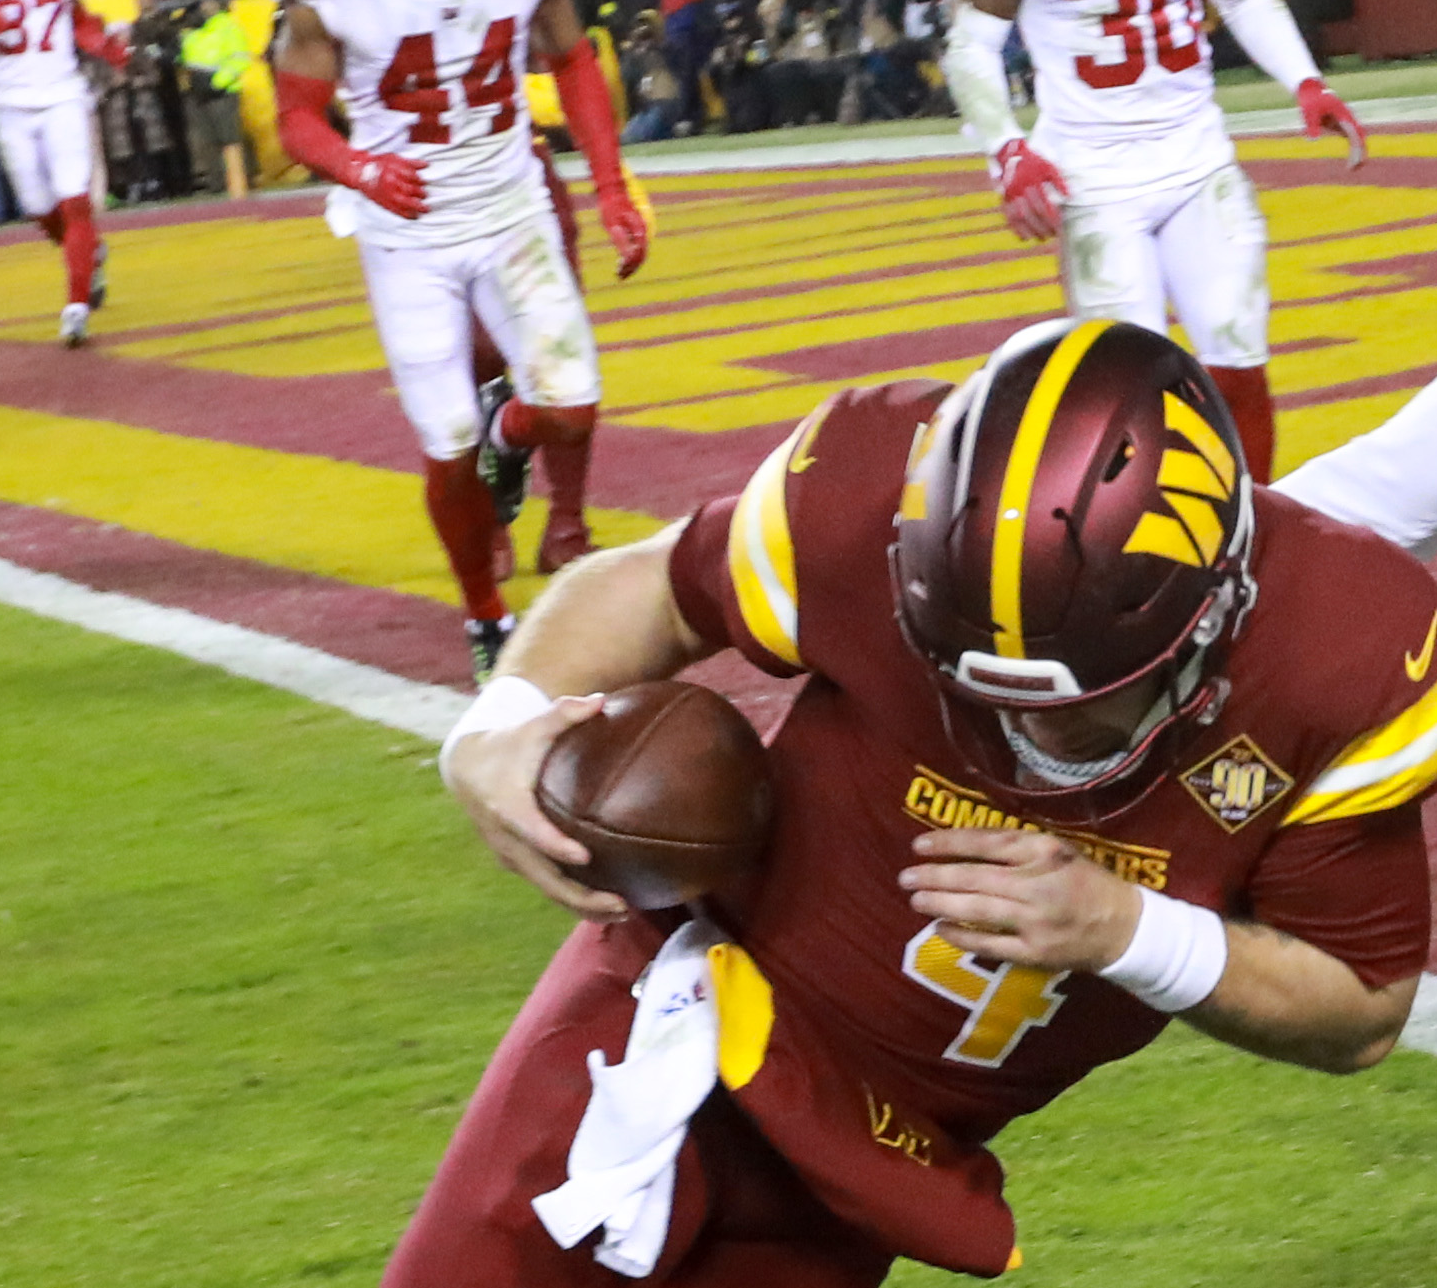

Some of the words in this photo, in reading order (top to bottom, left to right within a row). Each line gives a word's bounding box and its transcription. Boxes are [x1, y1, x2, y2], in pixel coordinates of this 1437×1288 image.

[377, 15, 519, 145] 44
[1209, 758, 1268, 810] 90
[901, 916, 1072, 1069] 4
